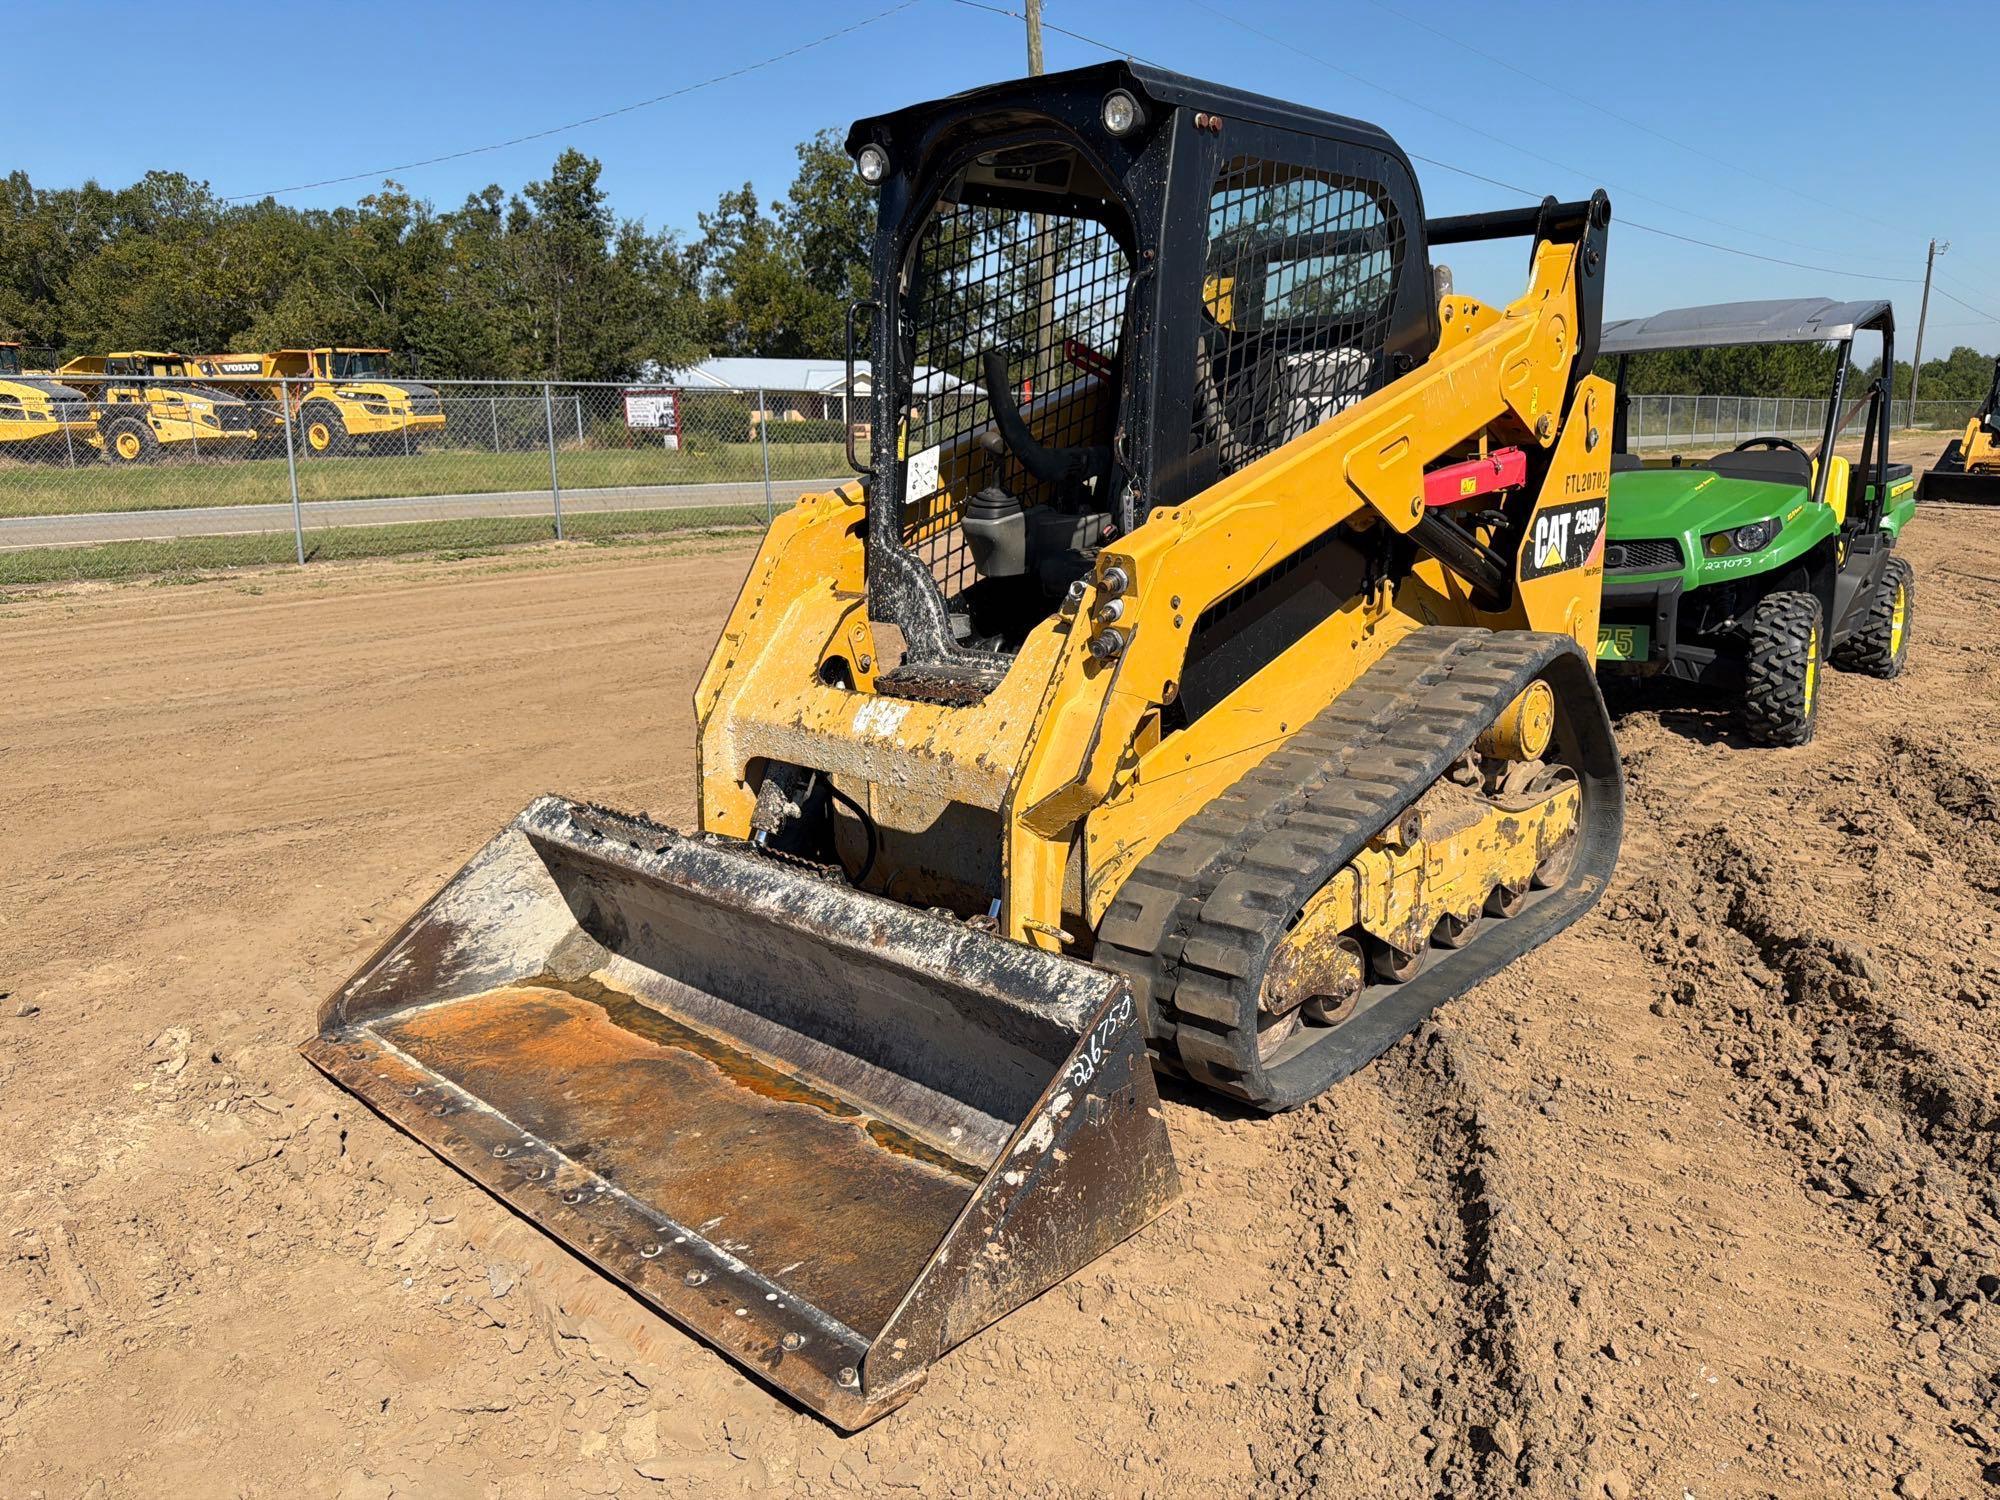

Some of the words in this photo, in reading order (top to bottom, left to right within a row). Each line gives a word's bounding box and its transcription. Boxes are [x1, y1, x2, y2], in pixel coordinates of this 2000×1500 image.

[222, 363, 259, 371] VOLVO
[1565, 471, 1607, 495] FTL20702
[1534, 512, 1571, 569] CAT
[1574, 507, 1600, 535] 259D
[1705, 557, 1752, 570] 227073
[1074, 995, 1130, 1087] 226750
